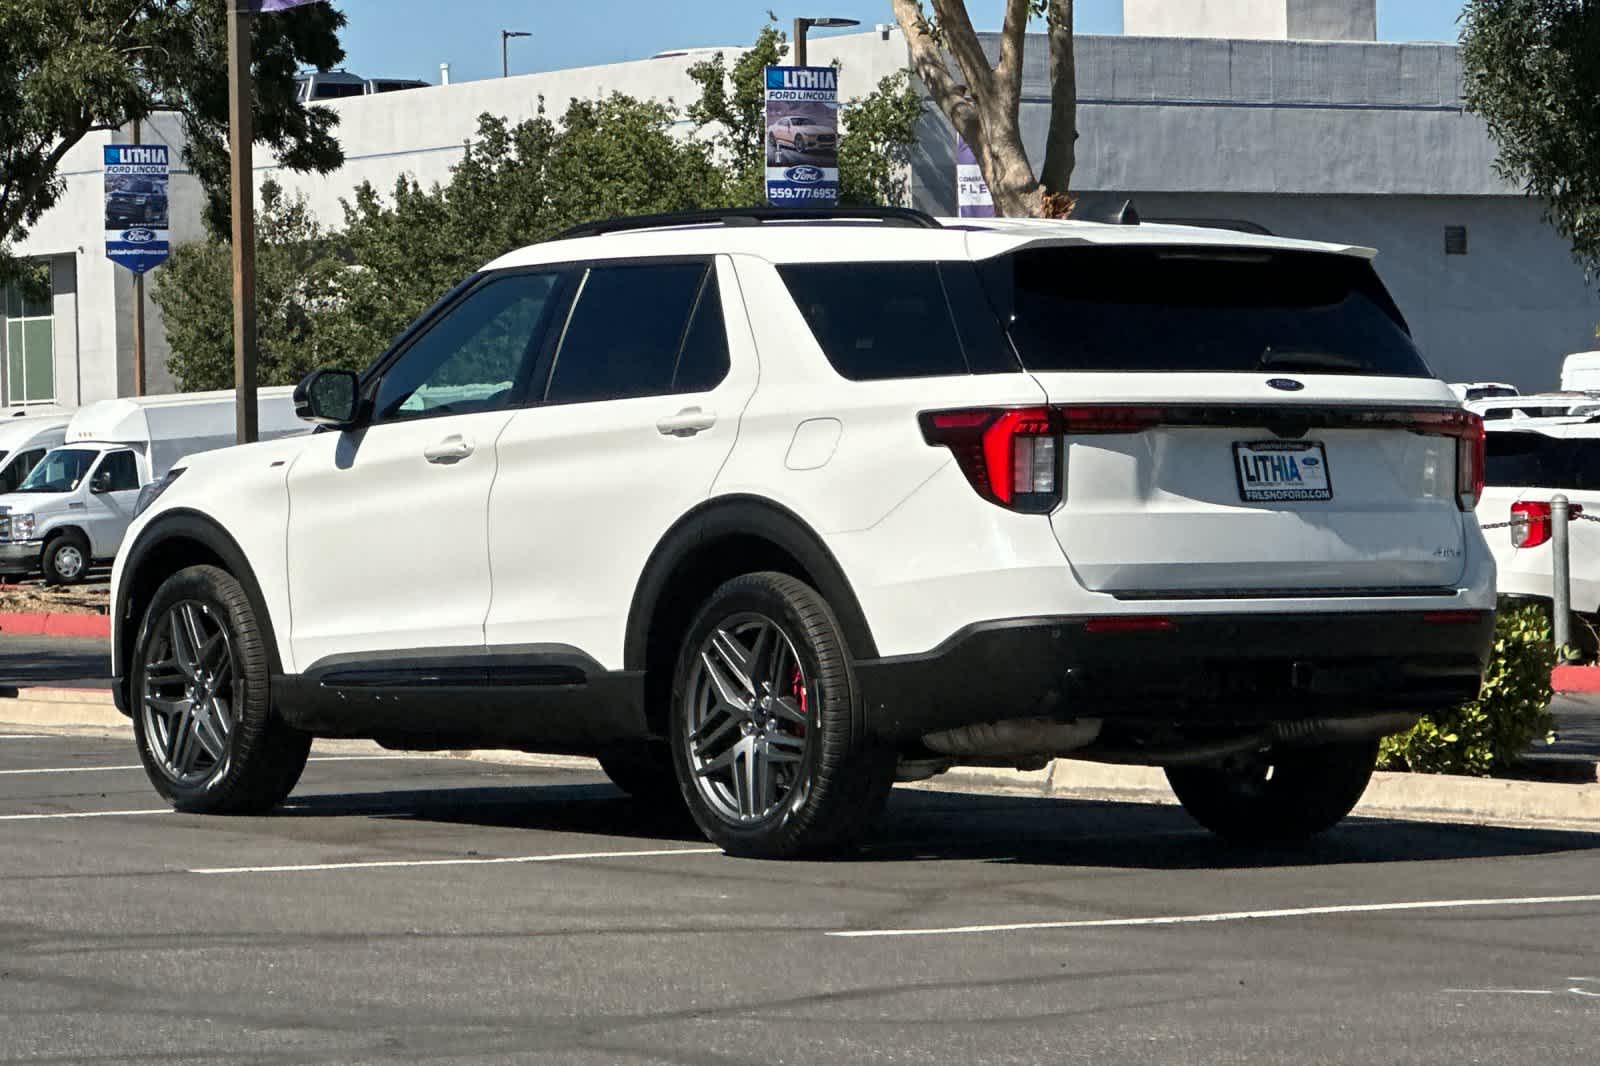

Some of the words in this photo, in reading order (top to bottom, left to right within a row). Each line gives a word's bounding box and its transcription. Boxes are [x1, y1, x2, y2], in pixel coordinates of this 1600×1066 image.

[783, 70, 836, 89] LITHIA
[768, 91, 797, 100] FORD
[798, 91, 836, 100] LINCOLN
[119, 148, 167, 163] LITHIA
[106, 166, 131, 174] FORD
[132, 166, 167, 174] LINCOLN
[792, 167, 819, 181] Ford
[769, 187, 837, 199] 559.777.6952
[127, 230, 152, 241] Ford
[1242, 455, 1303, 482] LITHIA
